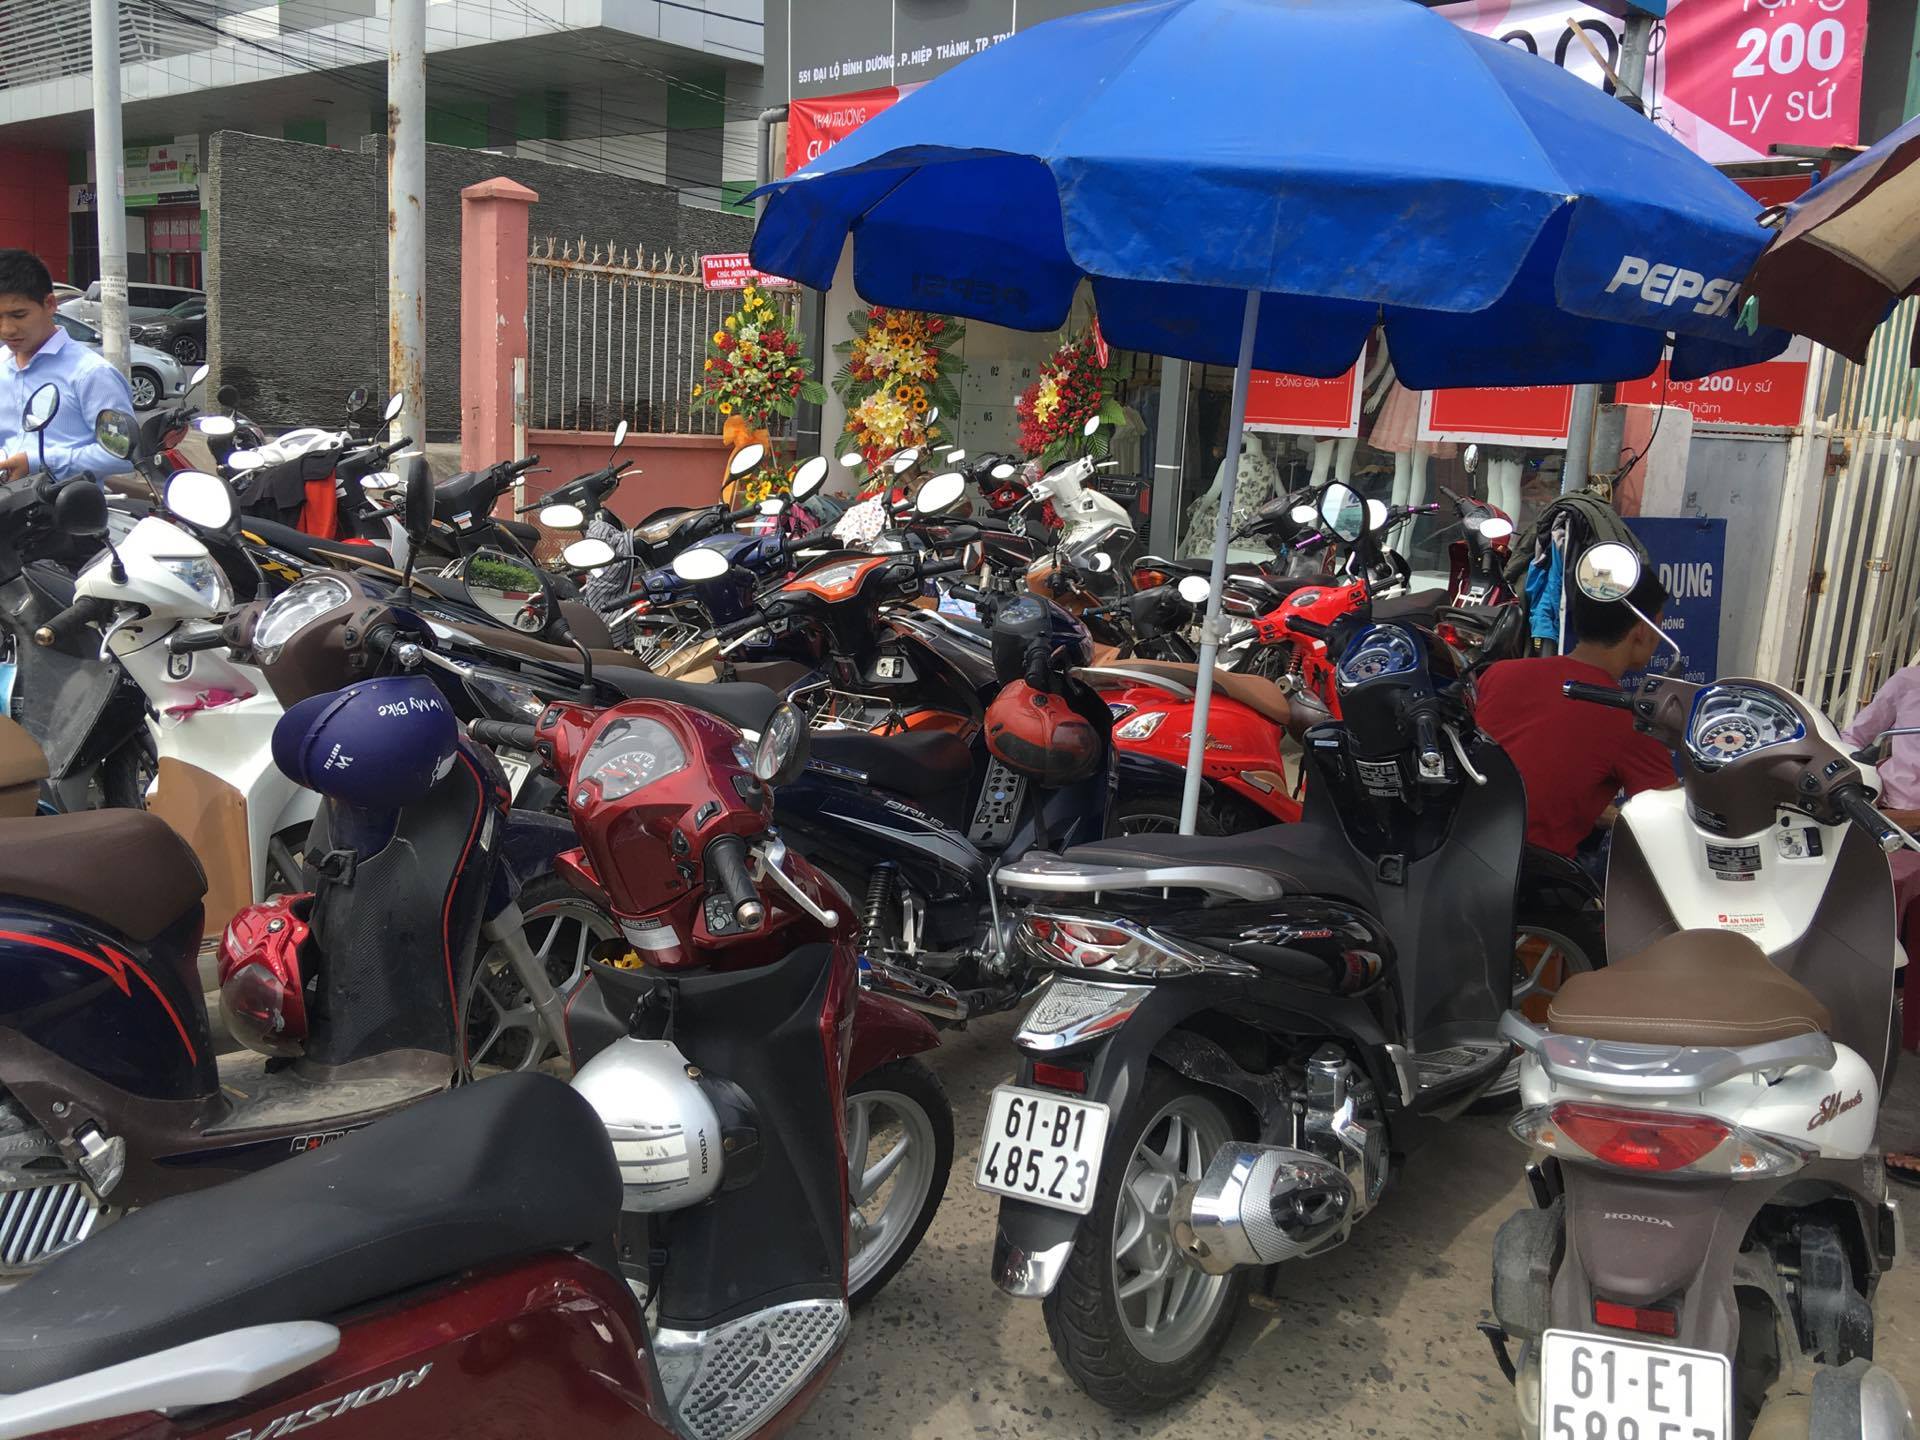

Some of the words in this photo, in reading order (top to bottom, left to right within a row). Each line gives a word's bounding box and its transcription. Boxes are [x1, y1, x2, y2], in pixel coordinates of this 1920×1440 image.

[1732, 18, 1845, 78] 200
[798, 71, 811, 83] 551
[813, 68, 827, 84] ĐẠI
[829, 61, 840, 80] LỘ
[842, 60, 863, 77] BÌNH
[1728, 87, 1773, 134] Ly
[1785, 77, 1838, 122] sứ
[1604, 255, 1741, 317] PEPSI
[990, 366, 999, 376] 02
[1698, 376, 1734, 392] 200
[1736, 381, 1751, 394] Ly
[1754, 379, 1773, 393] sứ
[1659, 562, 1713, 606] DỤNG
[1661, 616, 1685, 630] HÒNG
[378, 701, 408, 717] Bike
[1005, 1098, 1086, 1152] 61-B1
[698, 1128, 708, 1174] HONDA
[985, 1142, 1090, 1203] 485.23
[1603, 1211, 1675, 1229] HONDA
[1571, 1346, 1693, 1417] 61-E1
